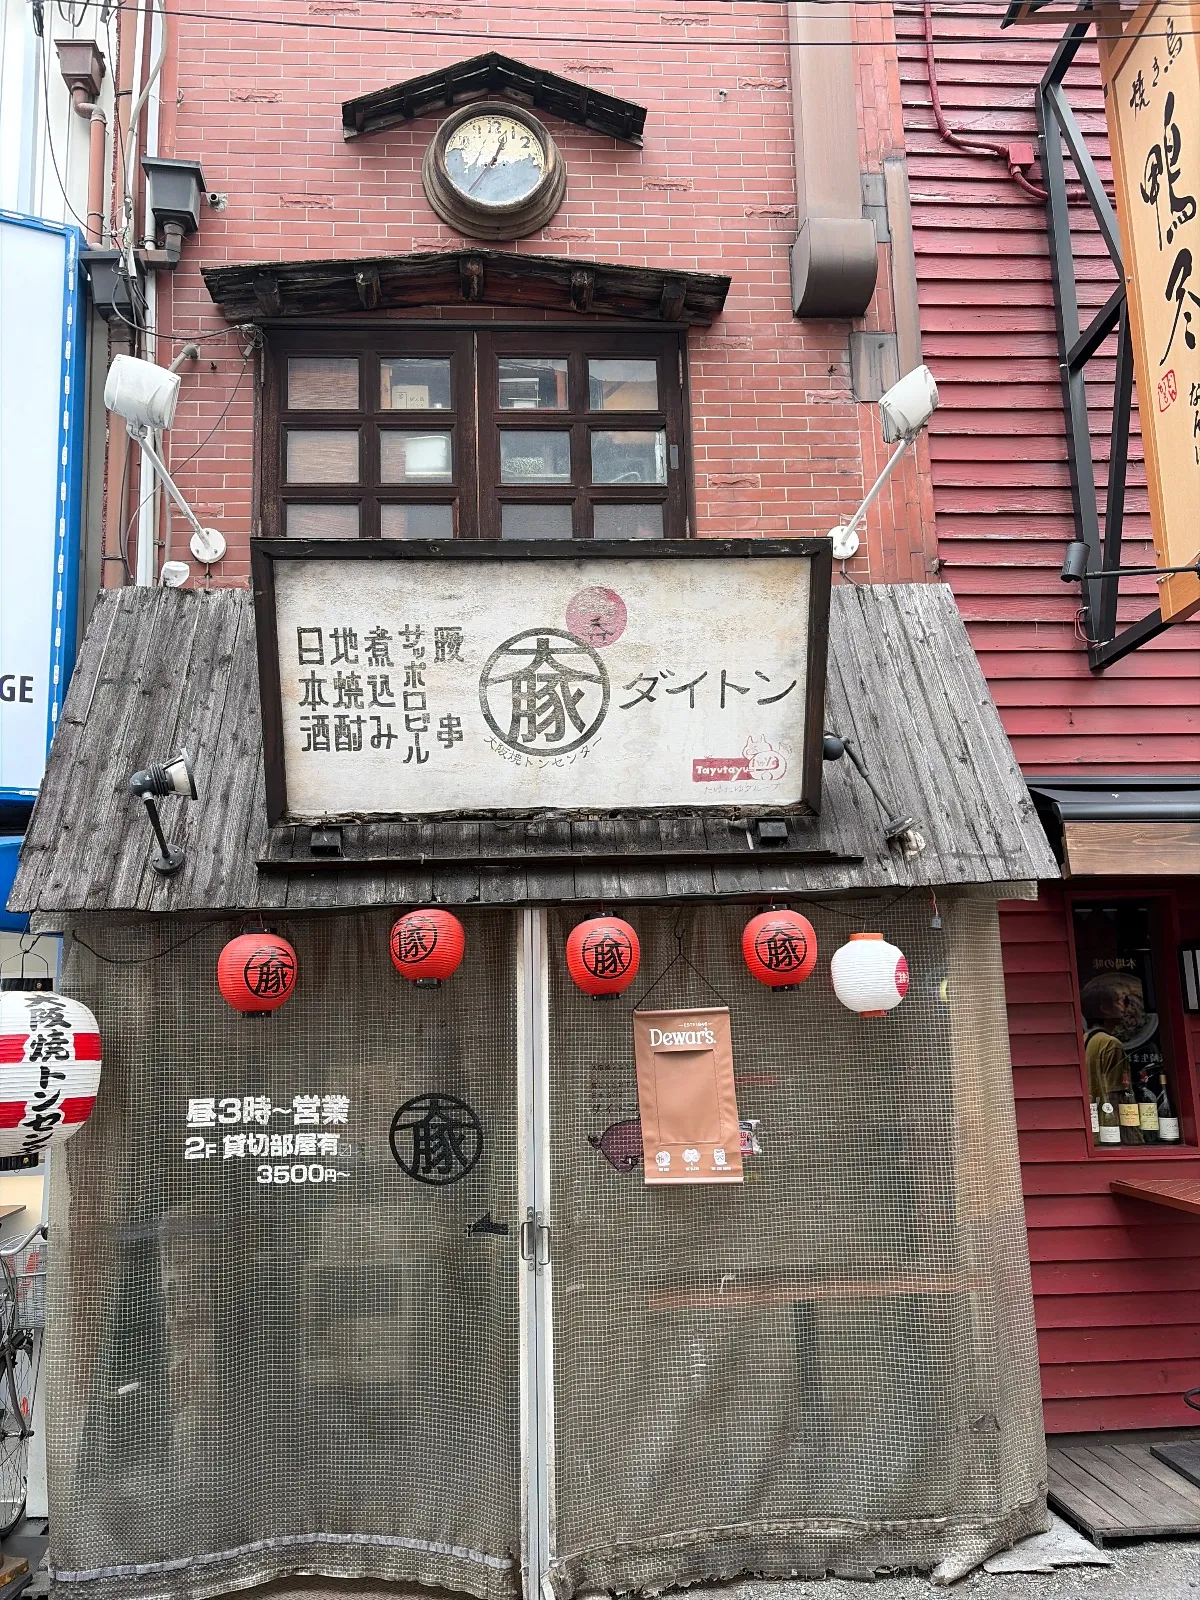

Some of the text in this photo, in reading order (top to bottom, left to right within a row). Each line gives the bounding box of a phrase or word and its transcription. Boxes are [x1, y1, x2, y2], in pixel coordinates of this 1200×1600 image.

[519, 135, 531, 149] 2
[0, 674, 34, 703] GE
[297, 626, 331, 752] 日本酒
[328, 626, 367, 752] 地焼酎
[363, 625, 398, 750] 煮込み
[398, 623, 431, 764] サッポロビール
[618, 668, 797, 710] ダイトン
[483, 735, 602, 769] 大阪焼トンセンター
[695, 765, 751, 781] Tayutayu
[184, 1136, 217, 1160] 2F
